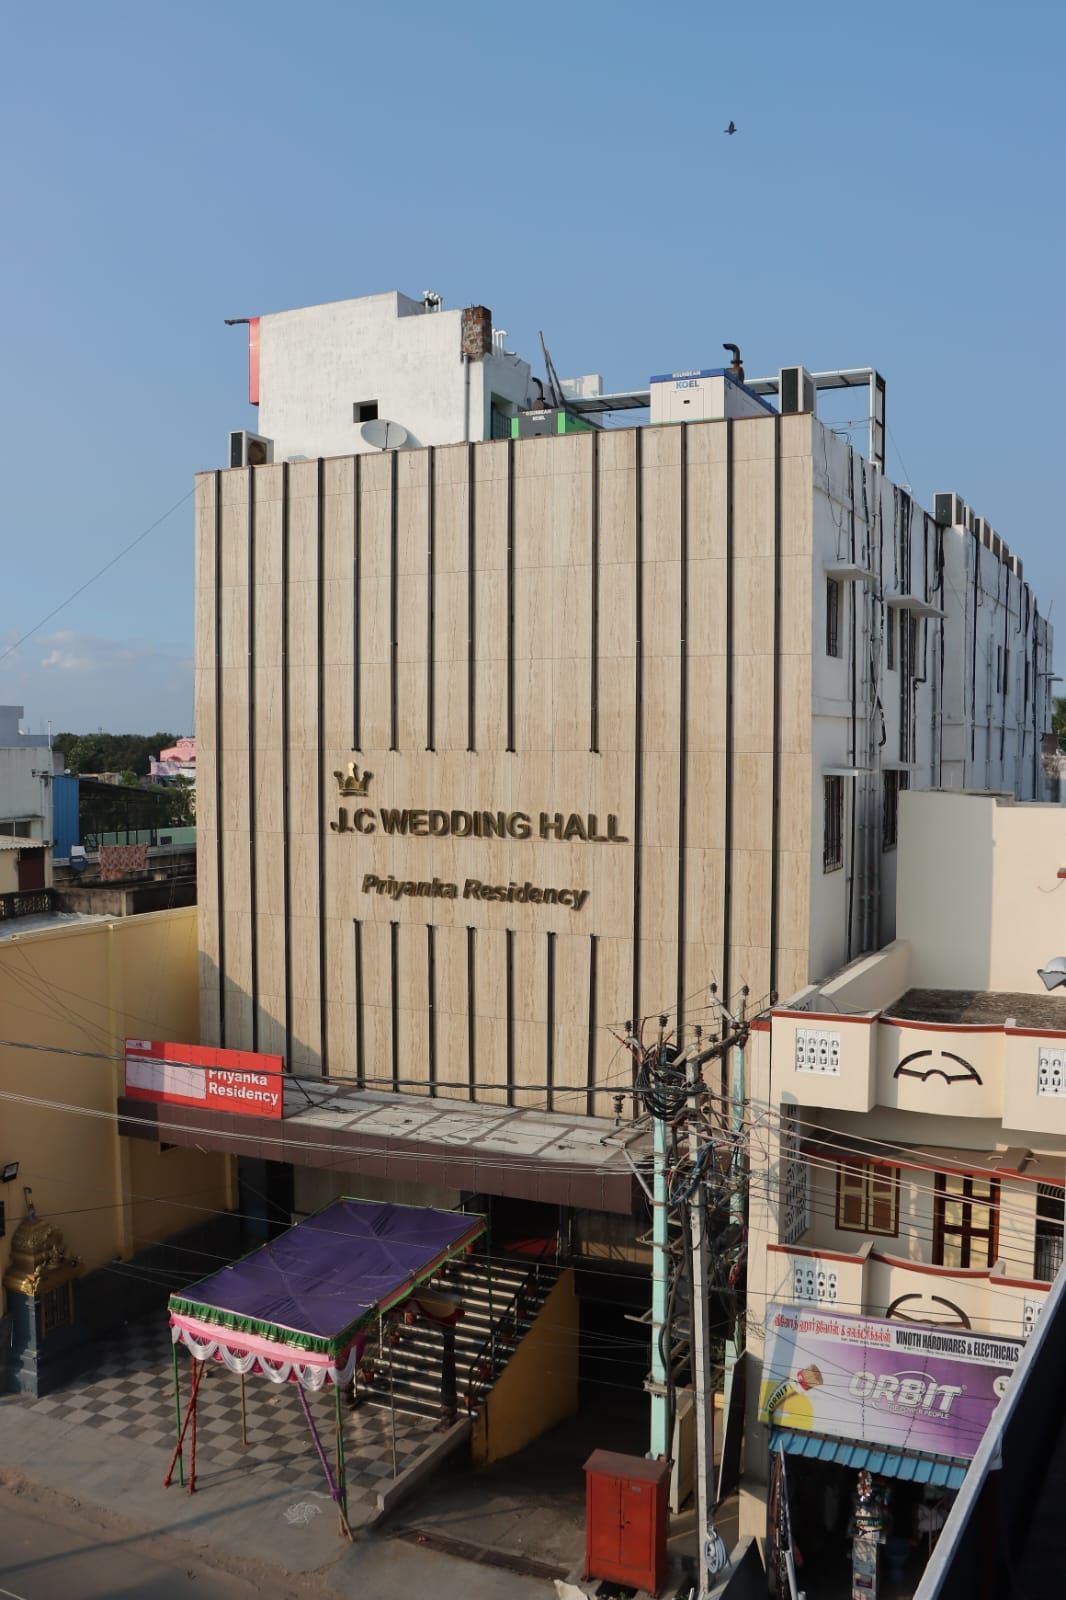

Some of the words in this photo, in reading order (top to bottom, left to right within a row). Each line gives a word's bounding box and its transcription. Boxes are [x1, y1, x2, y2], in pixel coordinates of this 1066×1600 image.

[676, 380, 700, 389] KOEL
[380, 808, 532, 839] WEDDING
[539, 811, 629, 843] HALL
[361, 873, 459, 901] Priyanka
[462, 878, 590, 912] Residency
[208, 1069, 268, 1086] Priyanka
[208, 1082, 278, 1106] Residency
[895, 1329, 922, 1348] VINOTH
[922, 1333, 966, 1355] HARDWARES
[967, 1343, 973, 1355] &
[973, 1341, 1019, 1362] ELECTRICALS
[768, 1384, 788, 1409] ORBIT
[848, 1371, 962, 1412] ORBIT
